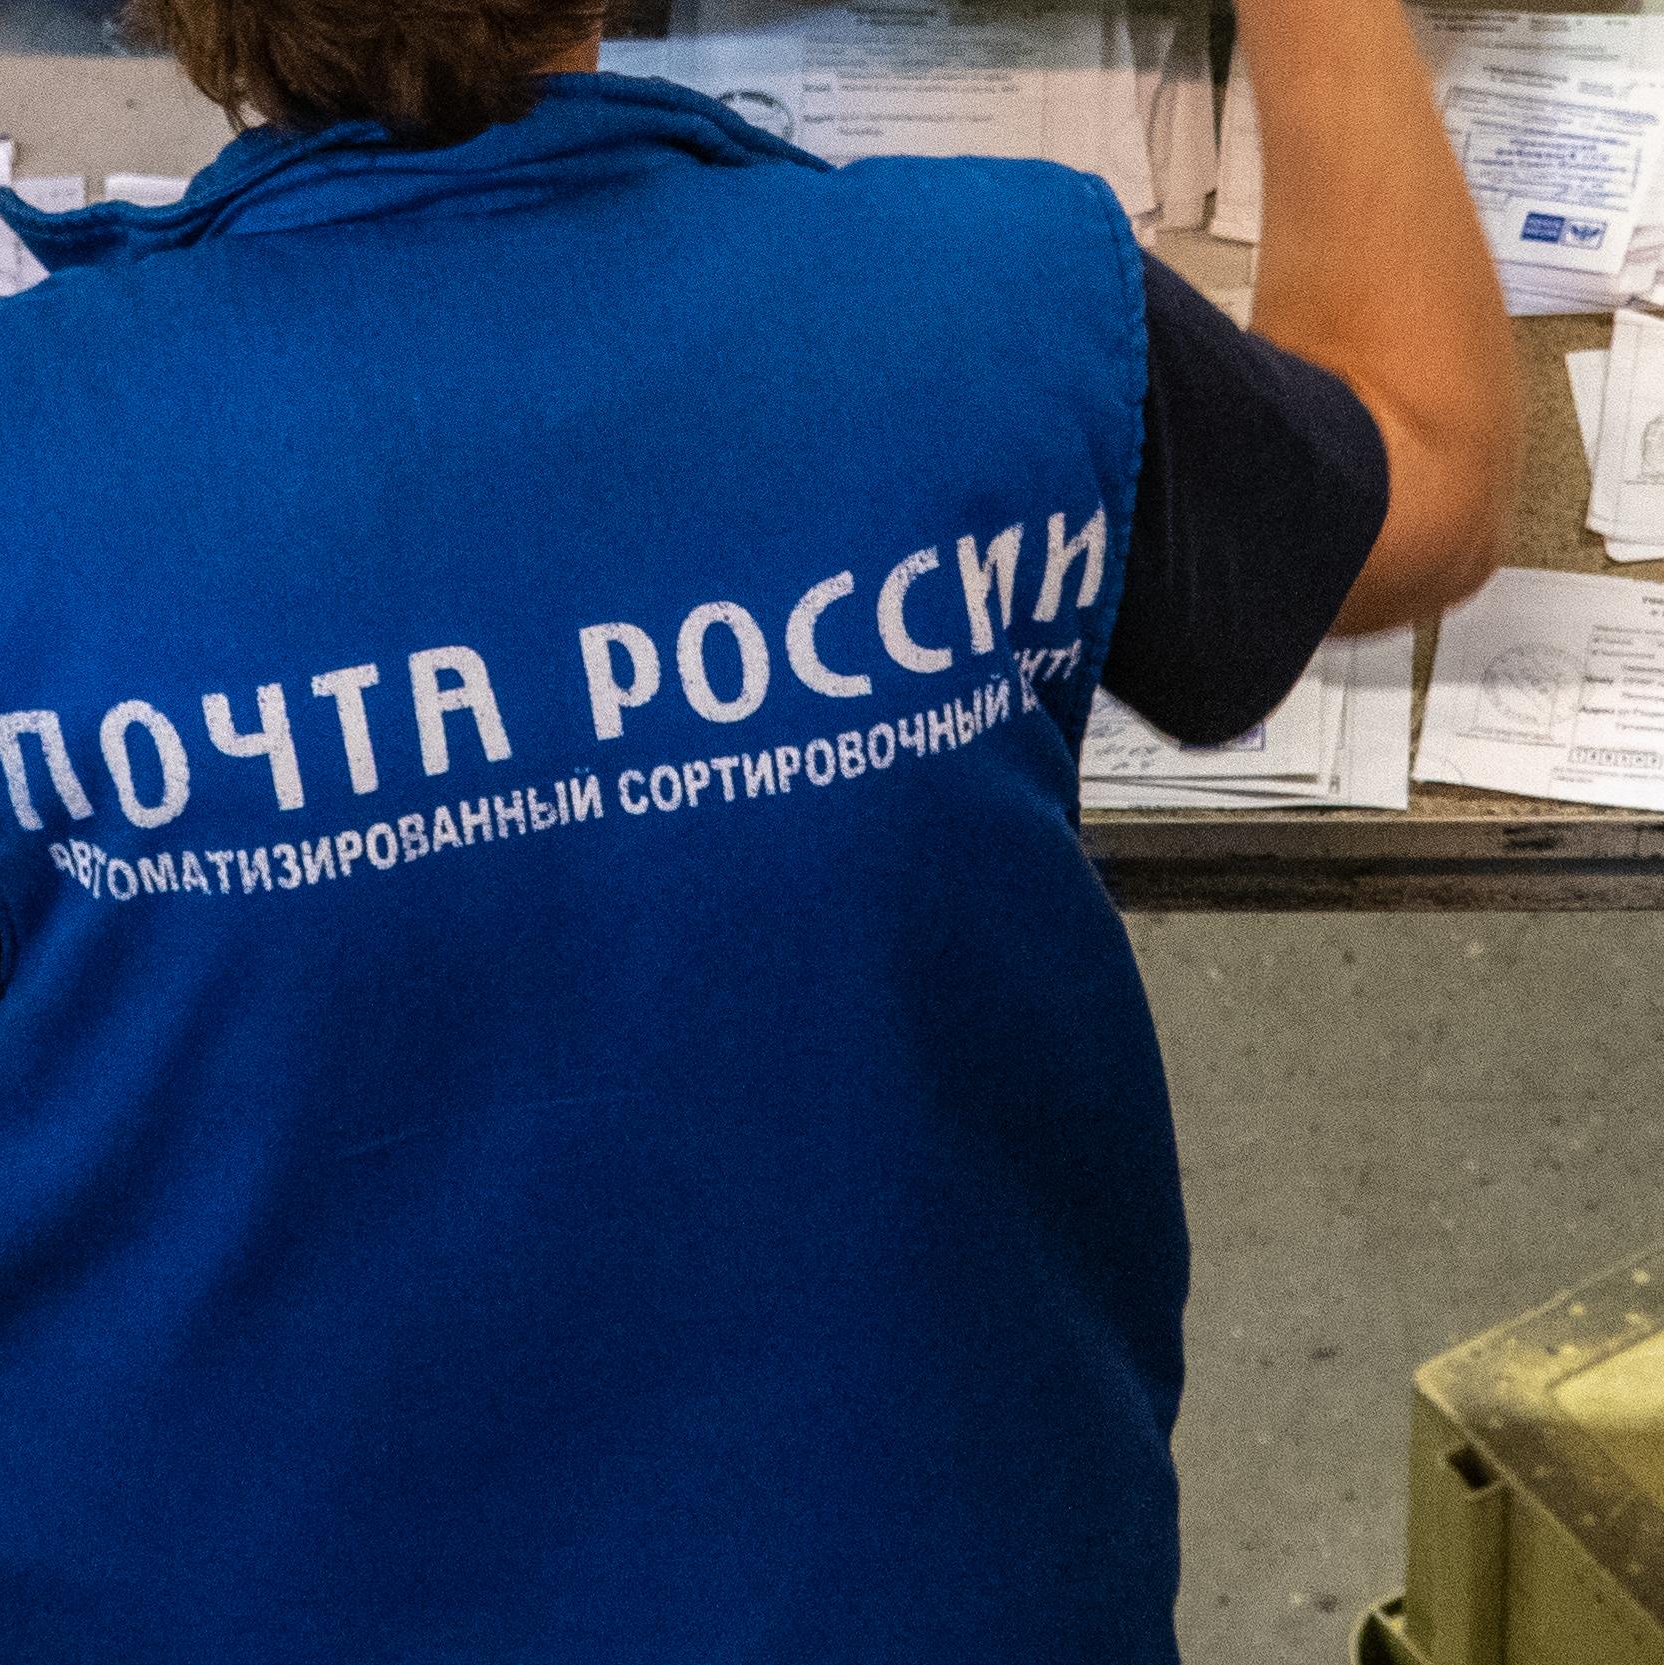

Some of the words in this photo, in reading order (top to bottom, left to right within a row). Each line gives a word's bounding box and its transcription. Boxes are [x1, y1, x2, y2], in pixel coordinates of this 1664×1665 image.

[579, 502, 1108, 740] РОССИИ
[48, 766, 605, 901] АВТОМАТИЗИРОВАННЫЙ
[617, 674, 1012, 816] СОРТИРОВОЧНЫЙ
